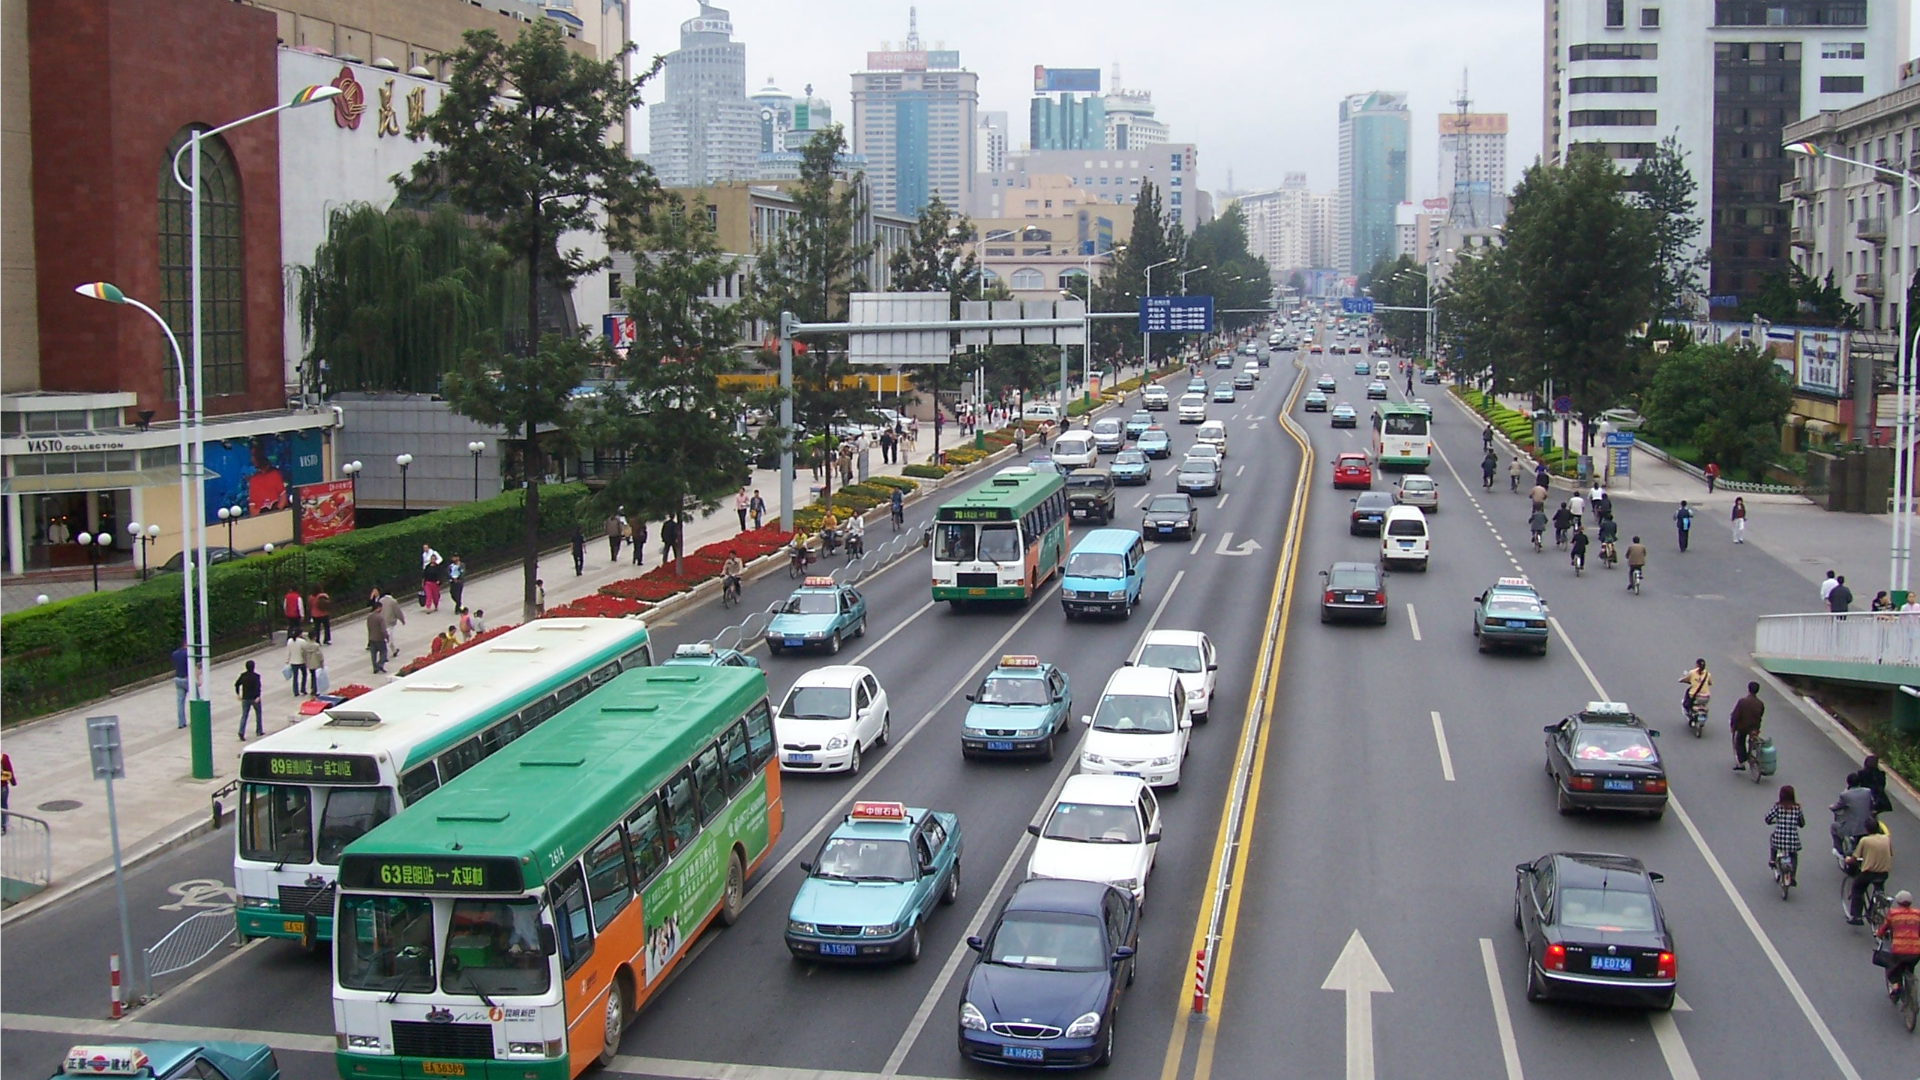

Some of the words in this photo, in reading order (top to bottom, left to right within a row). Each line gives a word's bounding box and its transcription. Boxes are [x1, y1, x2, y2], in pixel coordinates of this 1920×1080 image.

[28, 440, 62, 452] VASTO
[65, 443, 124, 451] COLLECTION
[300, 454, 318, 467] VASTO
